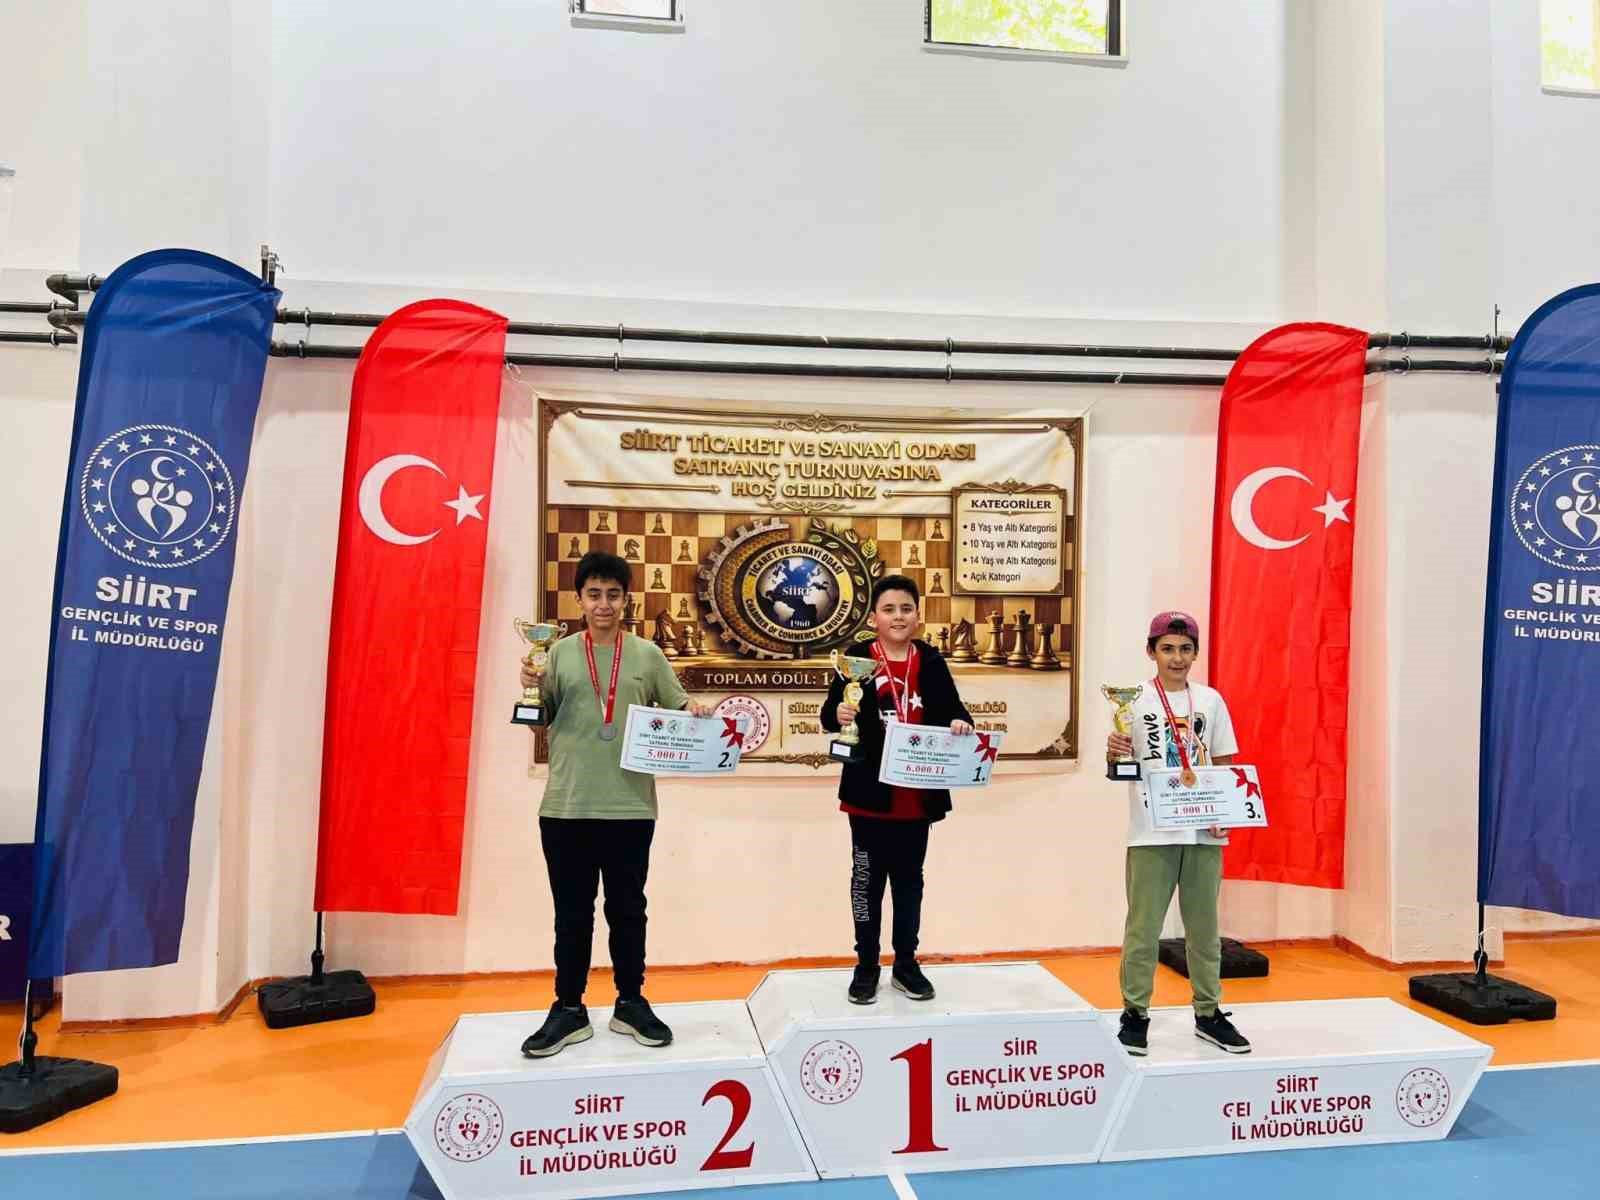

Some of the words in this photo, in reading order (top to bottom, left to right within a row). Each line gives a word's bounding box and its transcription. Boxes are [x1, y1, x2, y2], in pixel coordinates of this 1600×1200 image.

[620, 429, 681, 451] SİİRT
[686, 431, 785, 455] TİCARET
[789, 441, 816, 456] VE
[818, 440, 901, 459] SANAYİ
[905, 443, 977, 461] ODASI
[673, 457, 779, 480] SATRANÇ
[784, 462, 941, 481] TURNUVASINA
[731, 481, 778, 501] HOŞ
[782, 483, 877, 499] GELDİNİZ
[971, 498, 1052, 510] KATEGORİLER
[970, 523, 976, 531] 8
[978, 522, 992, 533] Yaş
[970, 540, 979, 548] 10
[981, 540, 994, 550] Yaş
[970, 556, 979, 564] 14
[981, 556, 994, 566] Yaş
[1021, 556, 1056, 567] Kategorisi
[970, 572, 987, 583] Açık
[989, 573, 1021, 582] Kategori
[95, 574, 198, 611] SİİRT
[62, 606, 142, 626] GENÇLİK
[147, 616, 170, 629] VE
[174, 619, 219, 635] SPOR
[1504, 609, 1577, 624] GENÇLİK
[71, 625, 89, 642] İL
[94, 630, 204, 652] MÜDÜRLÜĞÜ
[1515, 624, 1529, 638] İL
[704, 672, 767, 685] TOPLAM
[771, 671, 817, 685] ÖDÜL:
[1143, 712, 1162, 761] brave
[718, 751, 732, 768] 2.
[973, 766, 986, 782] 1.
[1244, 801, 1261, 819] 3.
[946, 1064, 1026, 1088] GENÇLİK
[1029, 1065, 1053, 1081] VE
[1057, 1063, 1105, 1081] SPOR
[1276, 1074, 1319, 1093] SİİRT
[574, 1094, 625, 1115] SİİRT
[890, 1037, 949, 1154] 1
[956, 1093, 972, 1112] İL
[1300, 1098, 1322, 1114] VE
[1326, 1095, 1371, 1112] SPOR
[510, 1123, 598, 1149] GENÇLİK
[603, 1124, 628, 1141] VE
[633, 1120, 687, 1139] SPOR
[700, 1079, 756, 1171] 2
[1232, 1121, 1246, 1140] İL
[1251, 1115, 1364, 1139] MÜDÜRLÜĞÜ
[520, 1155, 537, 1176] İL
[543, 1145, 677, 1174] MÜDÜRLÜĞÜ
